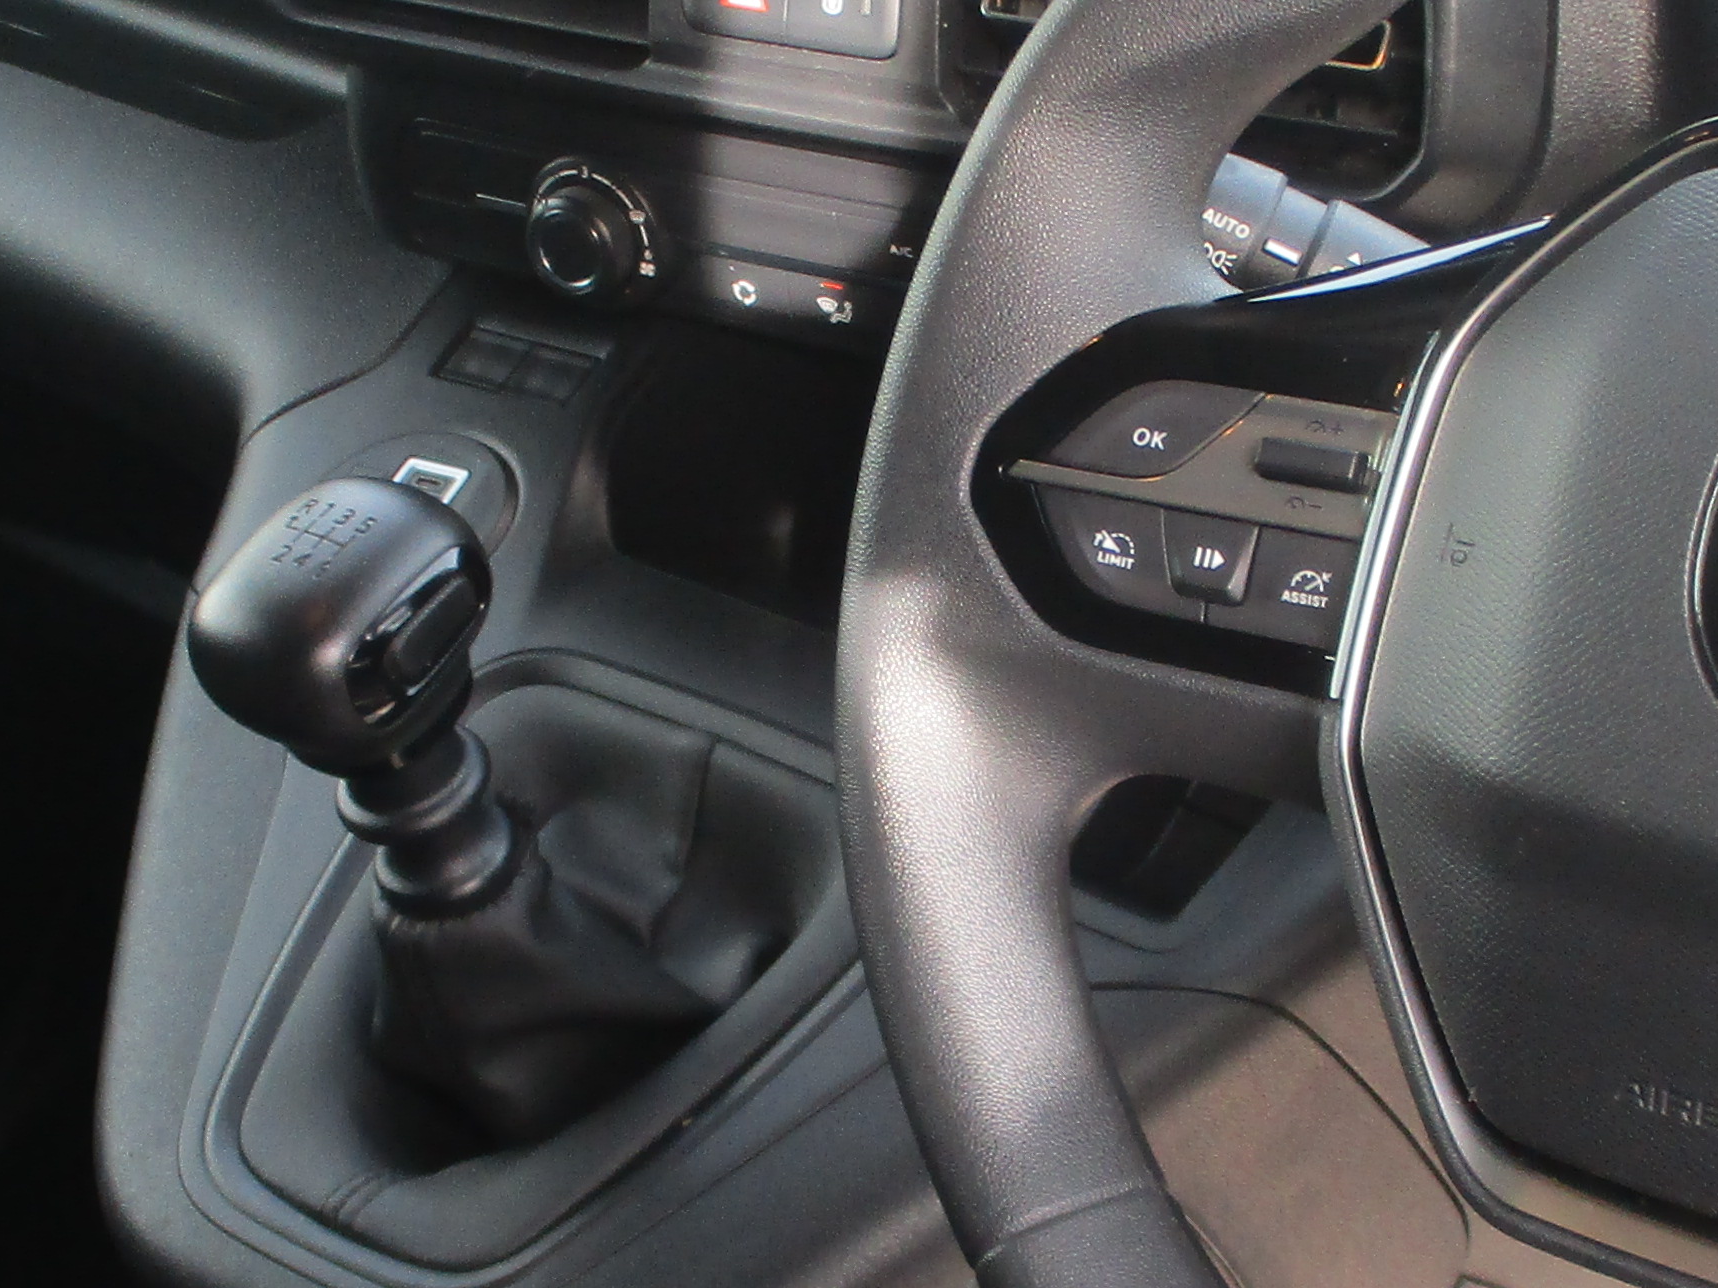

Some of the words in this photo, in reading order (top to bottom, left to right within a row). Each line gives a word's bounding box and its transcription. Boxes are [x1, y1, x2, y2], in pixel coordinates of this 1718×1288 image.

[1201, 206, 1251, 240] AUTO
[1132, 427, 1169, 451] OK
[1096, 551, 1135, 571] LIMIT
[1281, 590, 1329, 610] ASSIST
